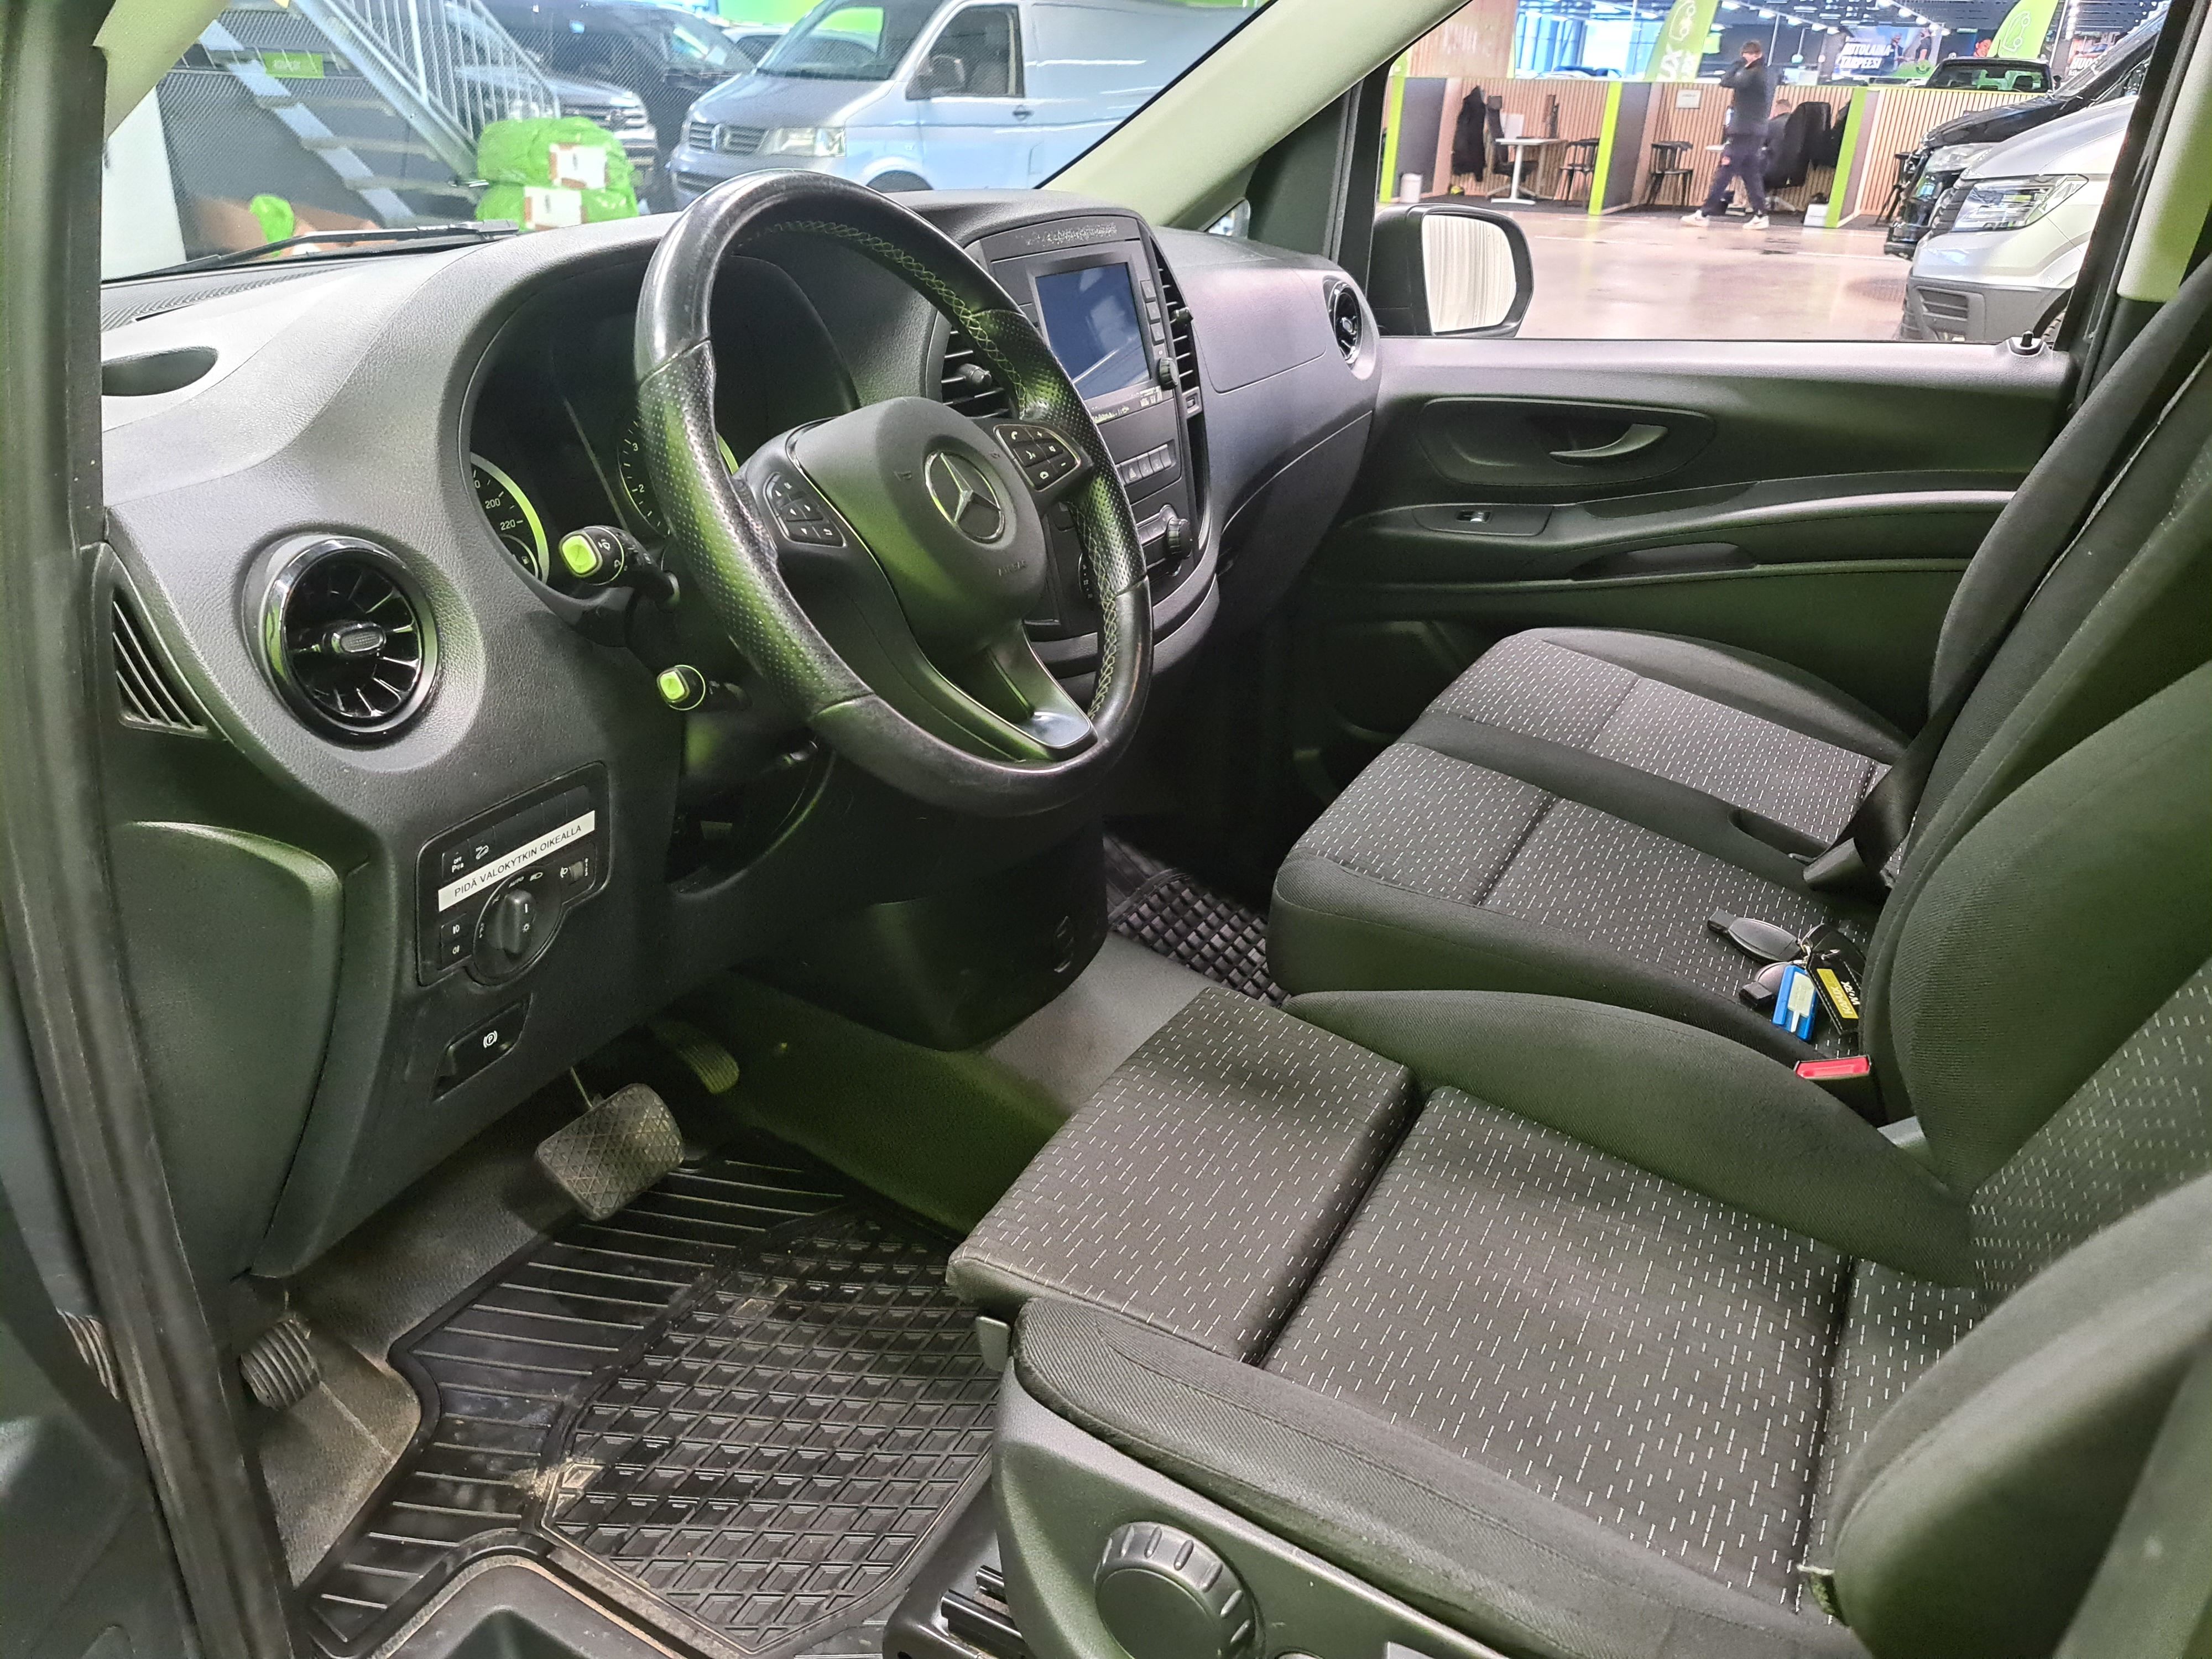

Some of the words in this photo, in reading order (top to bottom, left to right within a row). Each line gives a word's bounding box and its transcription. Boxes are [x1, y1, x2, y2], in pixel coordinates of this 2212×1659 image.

[633, 443, 638, 451] 3
[639, 484, 644, 493] 2
[485, 498, 500, 509] 200
[500, 519, 515, 531] 220
[454, 879, 477, 897] PIDÄ
[479, 847, 538, 882] VALOKYTKIN
[540, 825, 581, 851] OIKEALLA
[1830, 986, 1853, 1014] KAMUX
